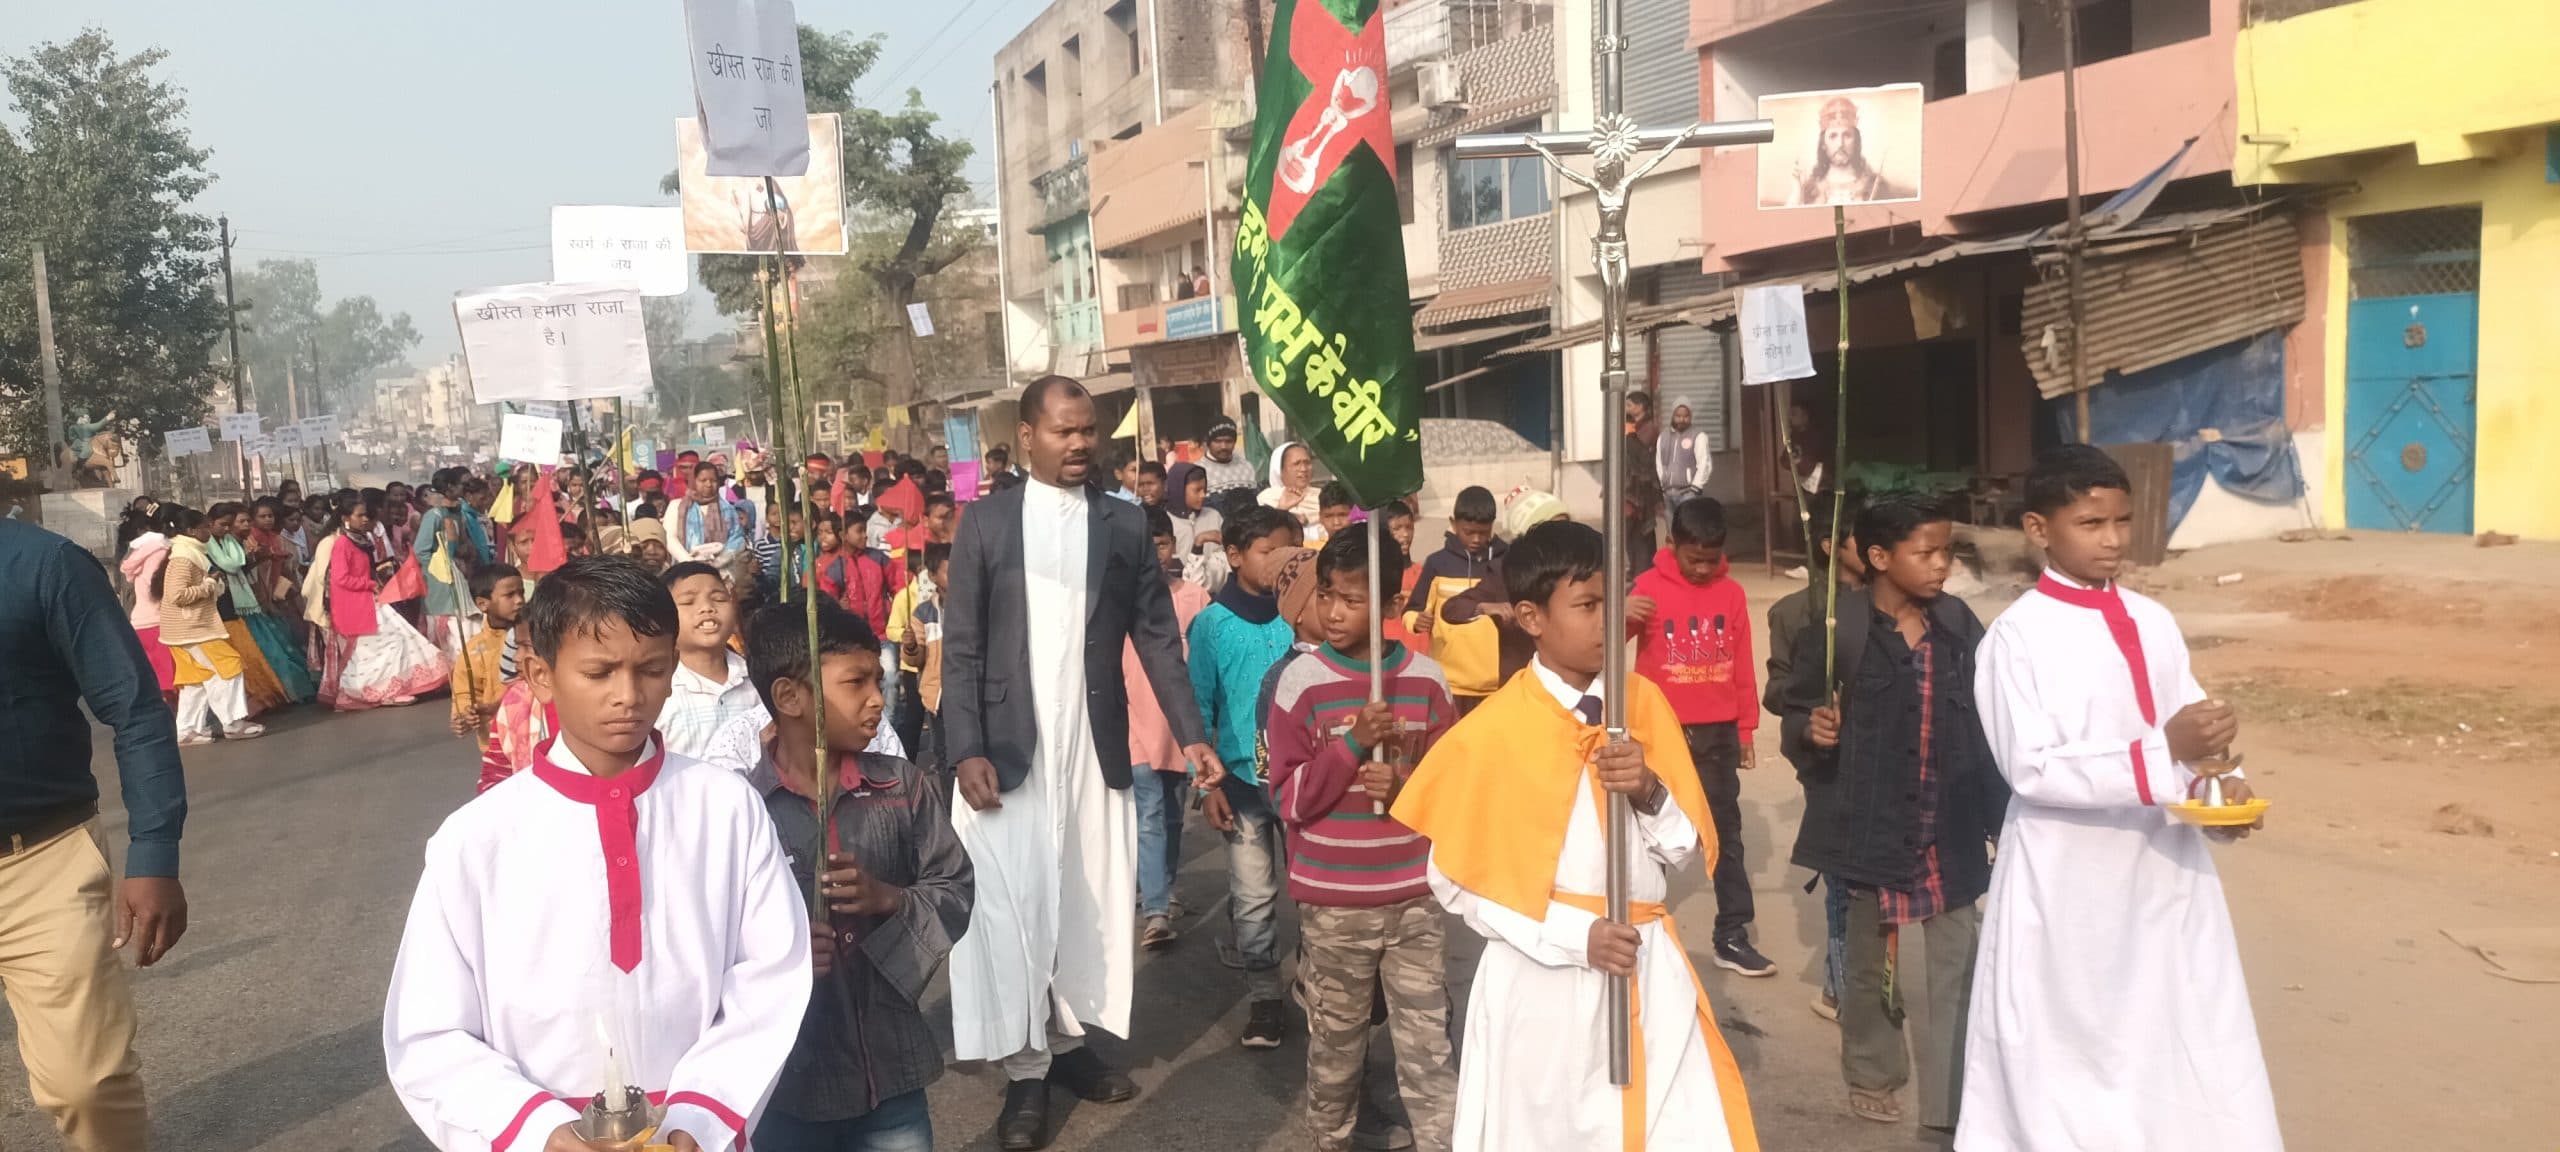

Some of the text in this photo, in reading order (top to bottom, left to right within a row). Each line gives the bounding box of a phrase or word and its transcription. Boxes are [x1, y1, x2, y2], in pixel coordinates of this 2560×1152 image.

[779, 54, 795, 86] की
[531, 303, 577, 320] हमारा
[585, 300, 624, 316] राजा
[1304, 332, 1348, 398] के
